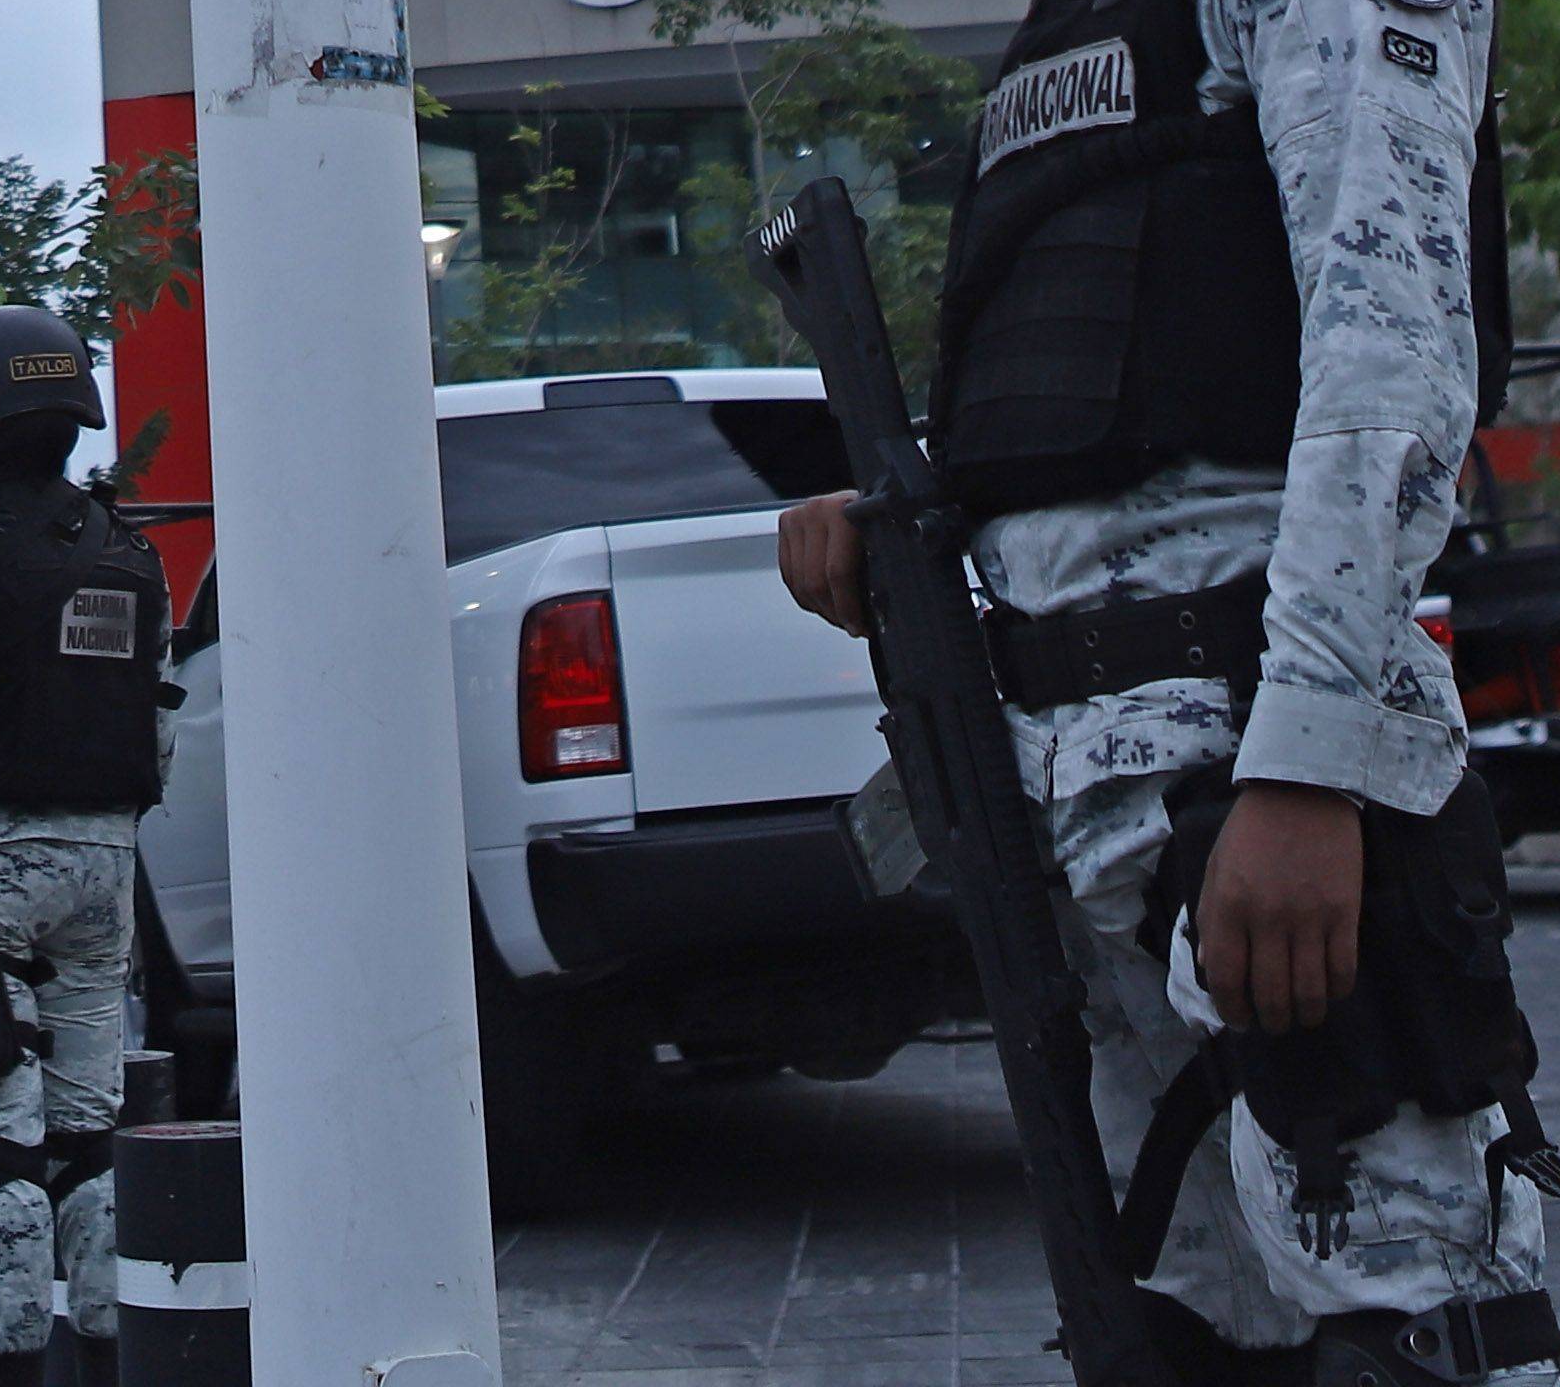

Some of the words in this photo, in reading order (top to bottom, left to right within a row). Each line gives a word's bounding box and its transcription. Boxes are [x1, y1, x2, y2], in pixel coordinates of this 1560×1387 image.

[1394, 38, 1430, 65] O+
[1013, 50, 1132, 141] NACIONAL
[14, 358, 73, 376] TAYLOR
[66, 625, 130, 654] NACIONAL
